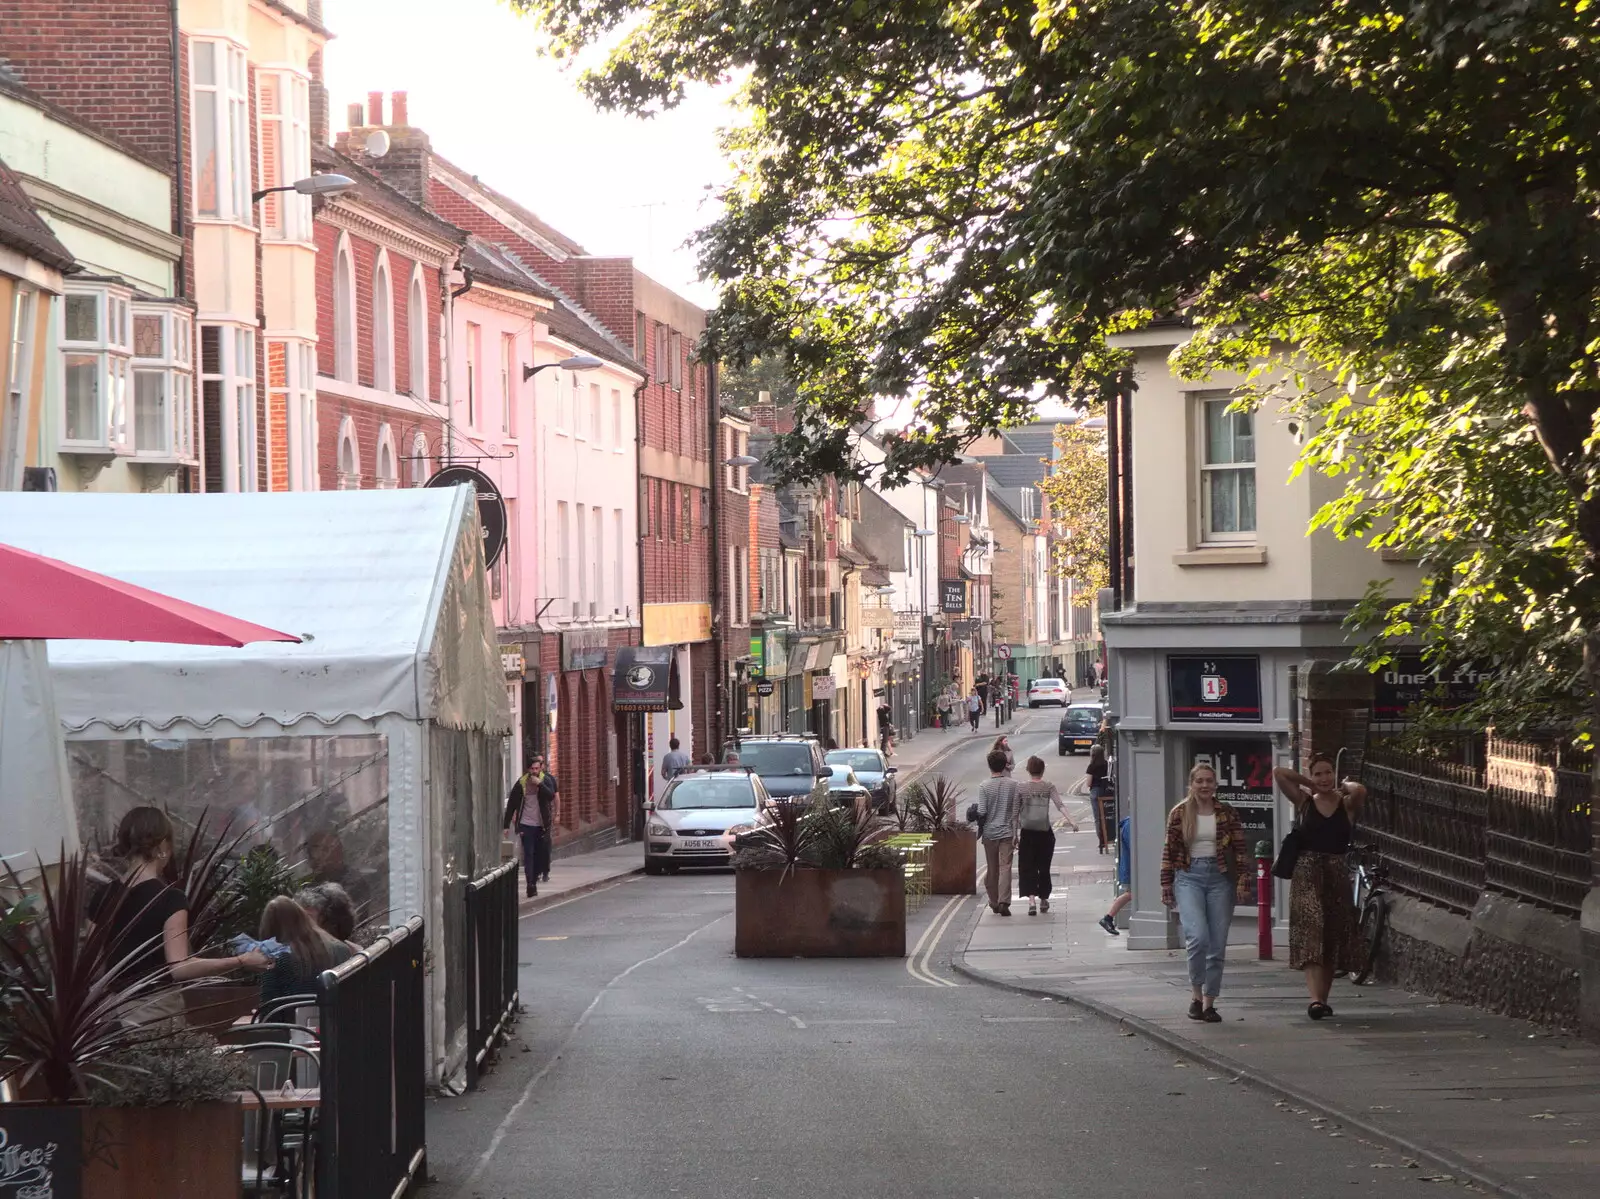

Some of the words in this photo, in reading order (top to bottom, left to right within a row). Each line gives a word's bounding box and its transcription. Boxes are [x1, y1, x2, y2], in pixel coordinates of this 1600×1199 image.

[945, 593, 963, 602] TEN
[1384, 671, 1427, 685] One
[1434, 670, 1491, 685] Life
[1207, 680, 1216, 695] 1
[615, 704, 637, 712] 01603
[1217, 792, 1236, 801] GAMES
